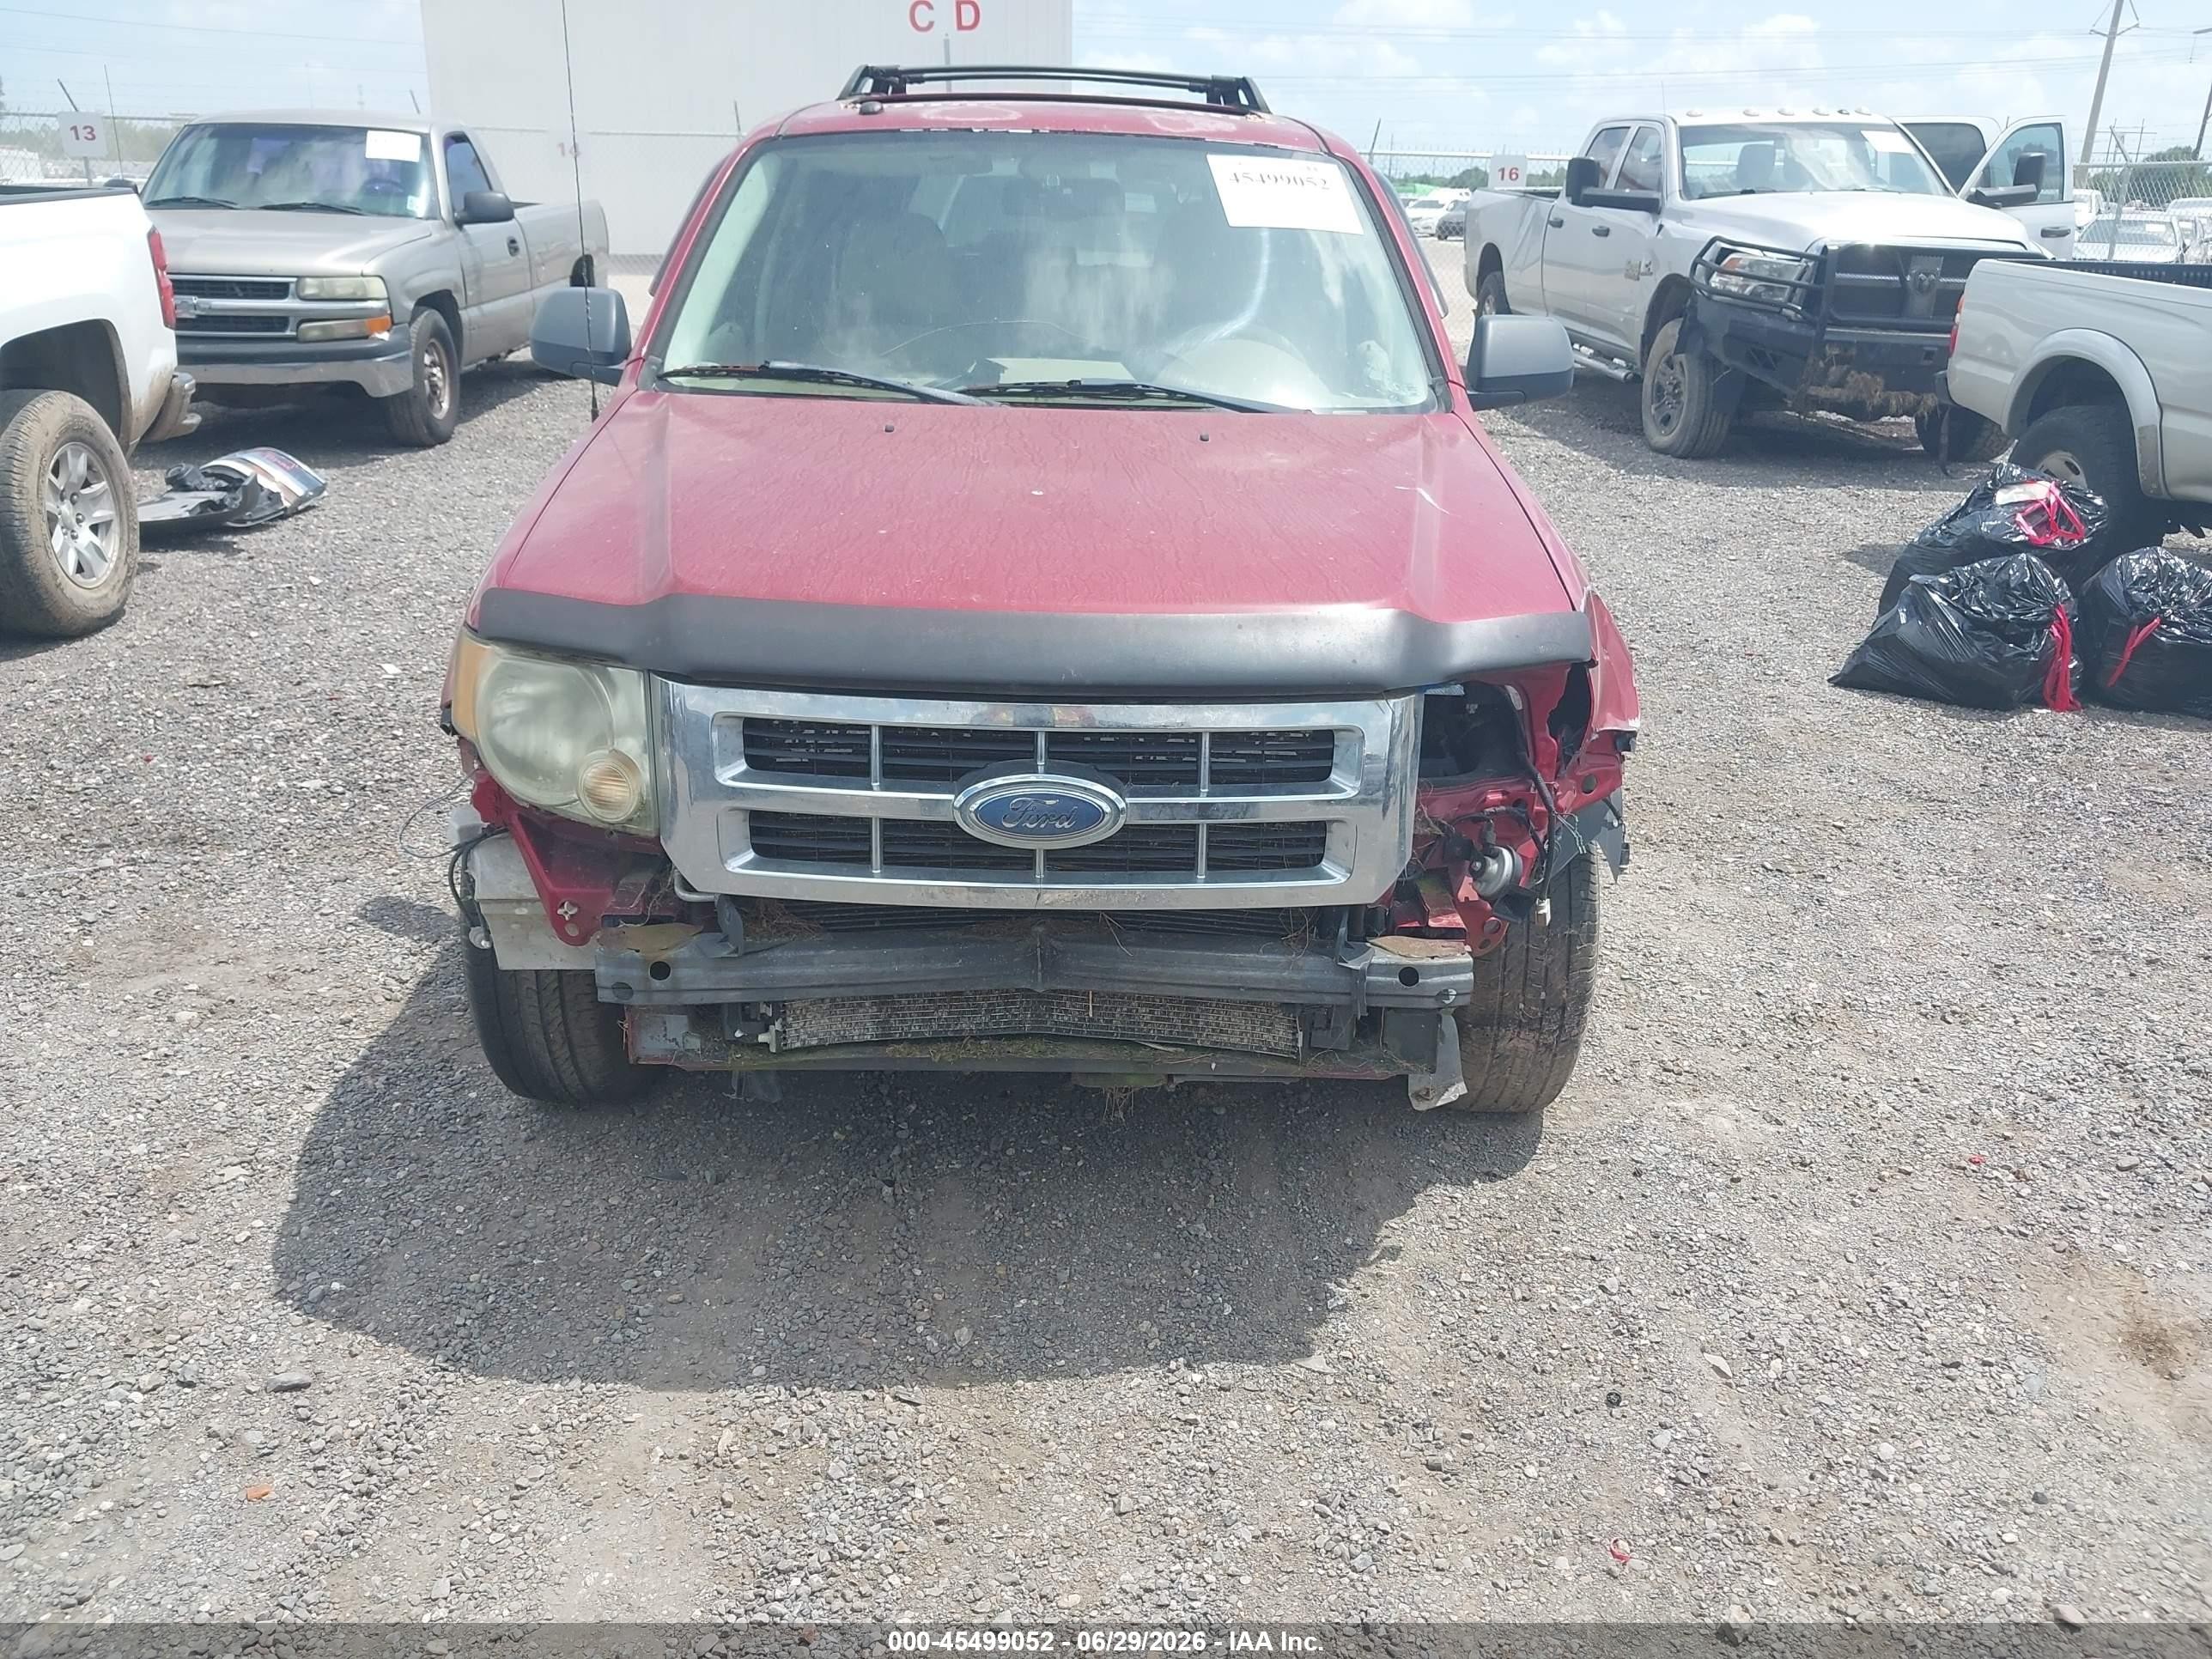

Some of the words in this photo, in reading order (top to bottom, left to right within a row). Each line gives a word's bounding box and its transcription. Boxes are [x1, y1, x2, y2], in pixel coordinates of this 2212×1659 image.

[908, 0, 935, 33] C
[956, 0, 981, 31] D
[70, 125, 96, 141] 13
[1229, 171, 1330, 191] 45499052
[1498, 167, 1519, 181] 16
[1001, 797, 1079, 829] Ford
